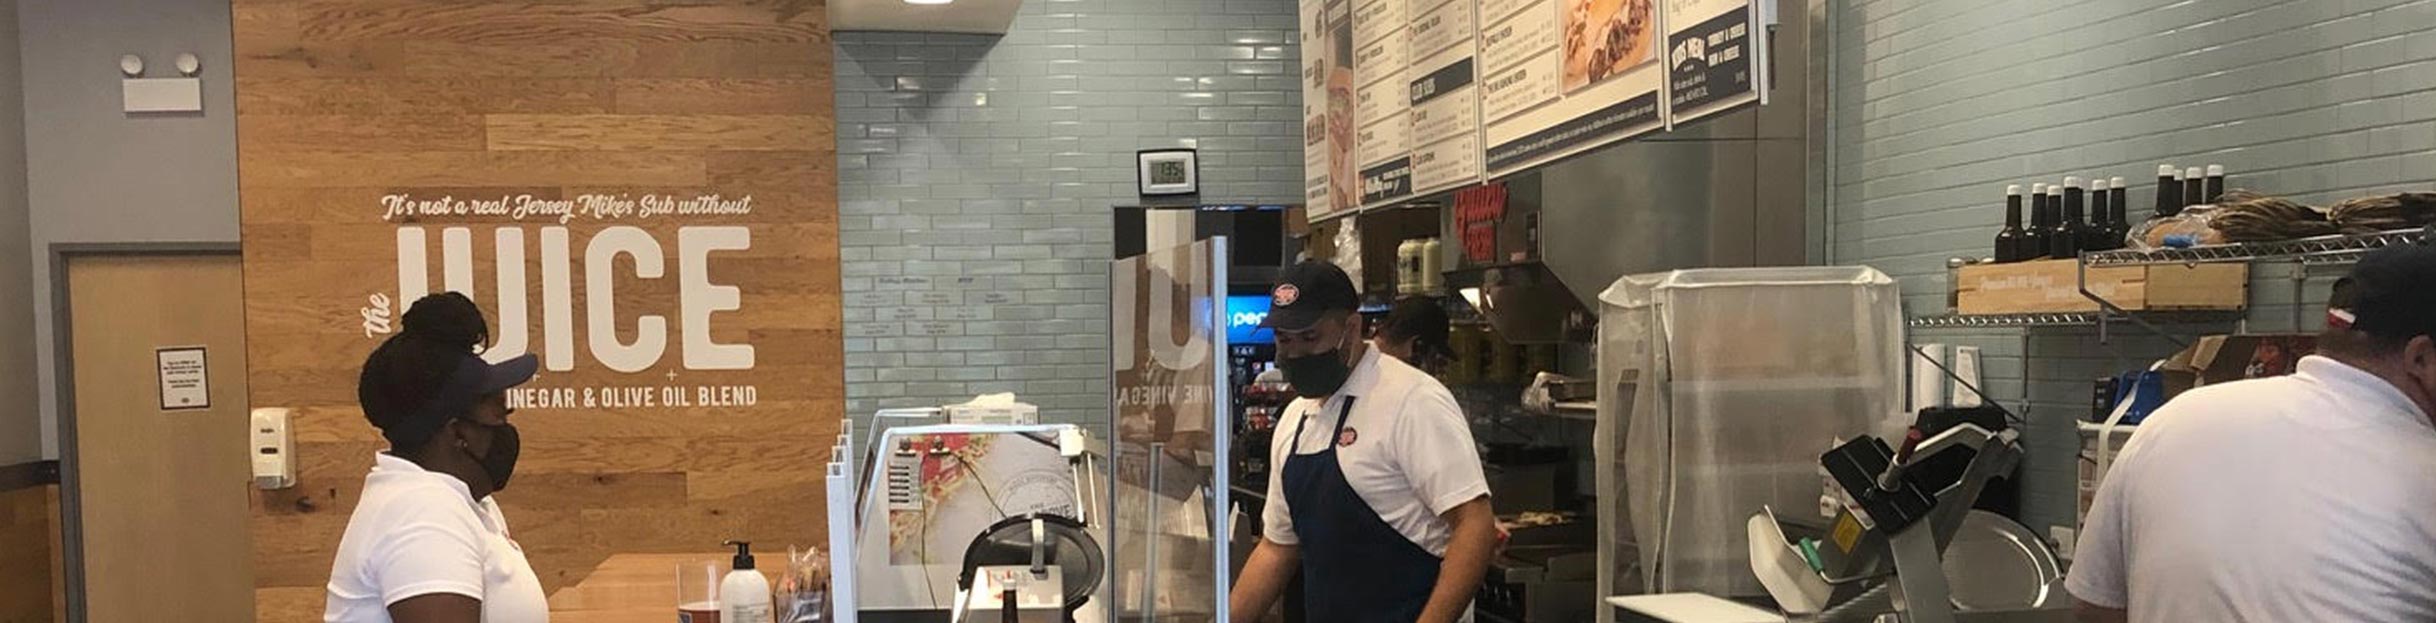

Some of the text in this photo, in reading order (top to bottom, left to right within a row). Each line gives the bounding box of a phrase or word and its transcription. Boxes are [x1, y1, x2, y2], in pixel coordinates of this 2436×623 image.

[381, 193, 752, 224] It's not a real Jersey Mike's Sub without
[361, 292, 391, 339] the
[506, 385, 757, 409] INEGAR & OLIVE OIL BLEND
